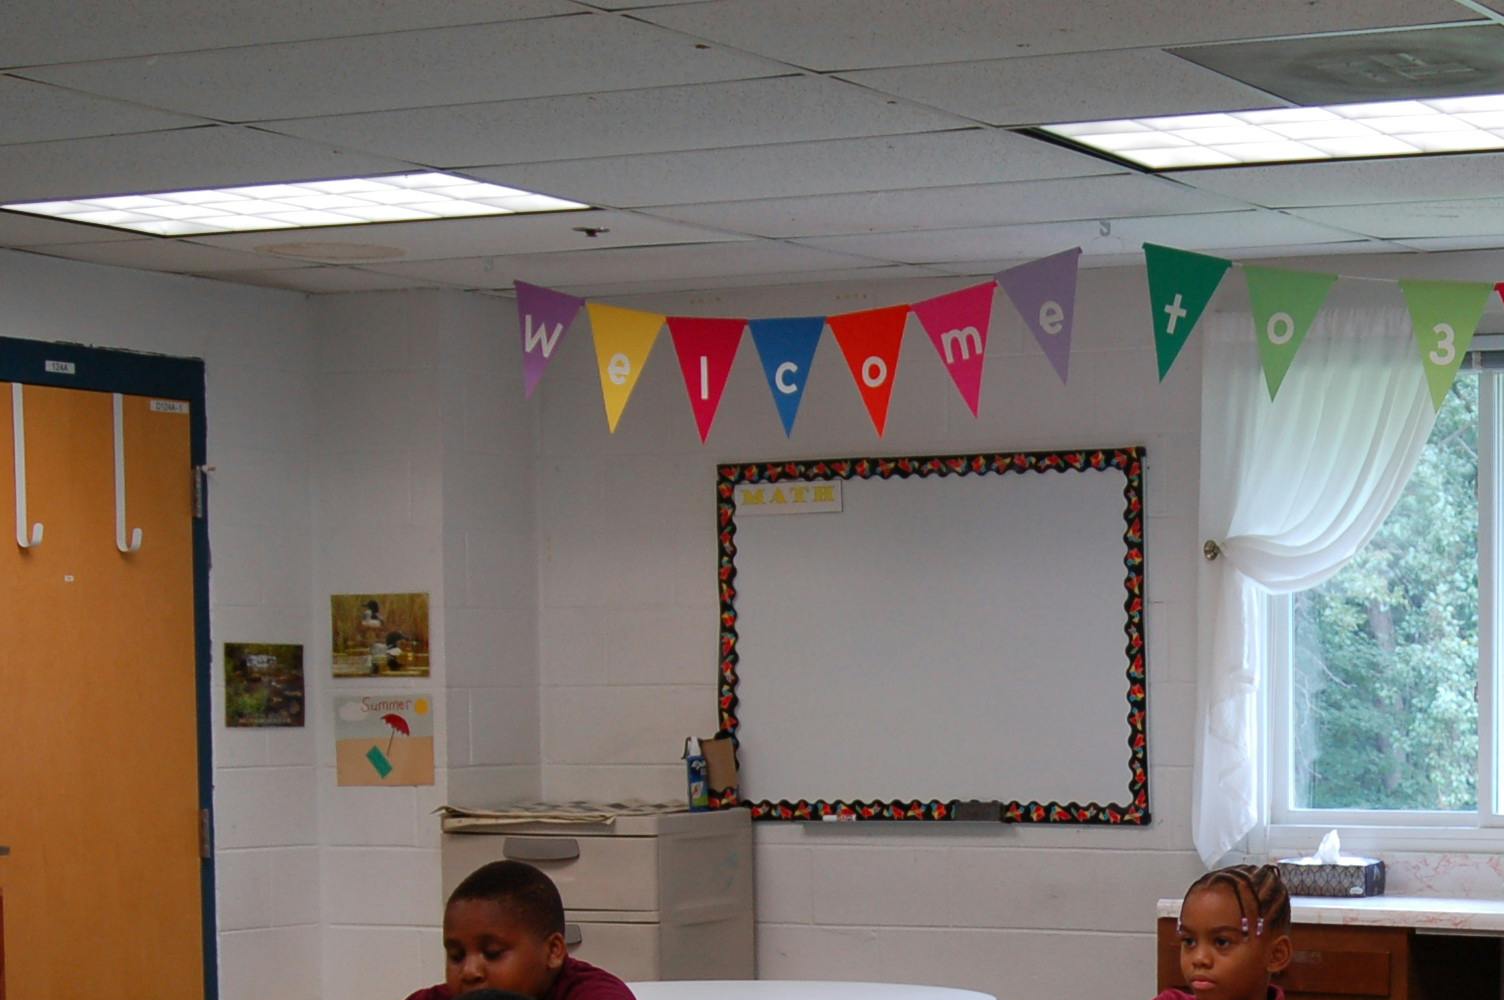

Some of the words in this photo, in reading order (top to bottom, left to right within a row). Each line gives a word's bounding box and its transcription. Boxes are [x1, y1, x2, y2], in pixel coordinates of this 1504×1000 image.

[524, 301, 1065, 400] Welcome
[1162, 292, 1295, 346] to
[741, 485, 835, 505] MATH
[361, 696, 412, 712] Summer
